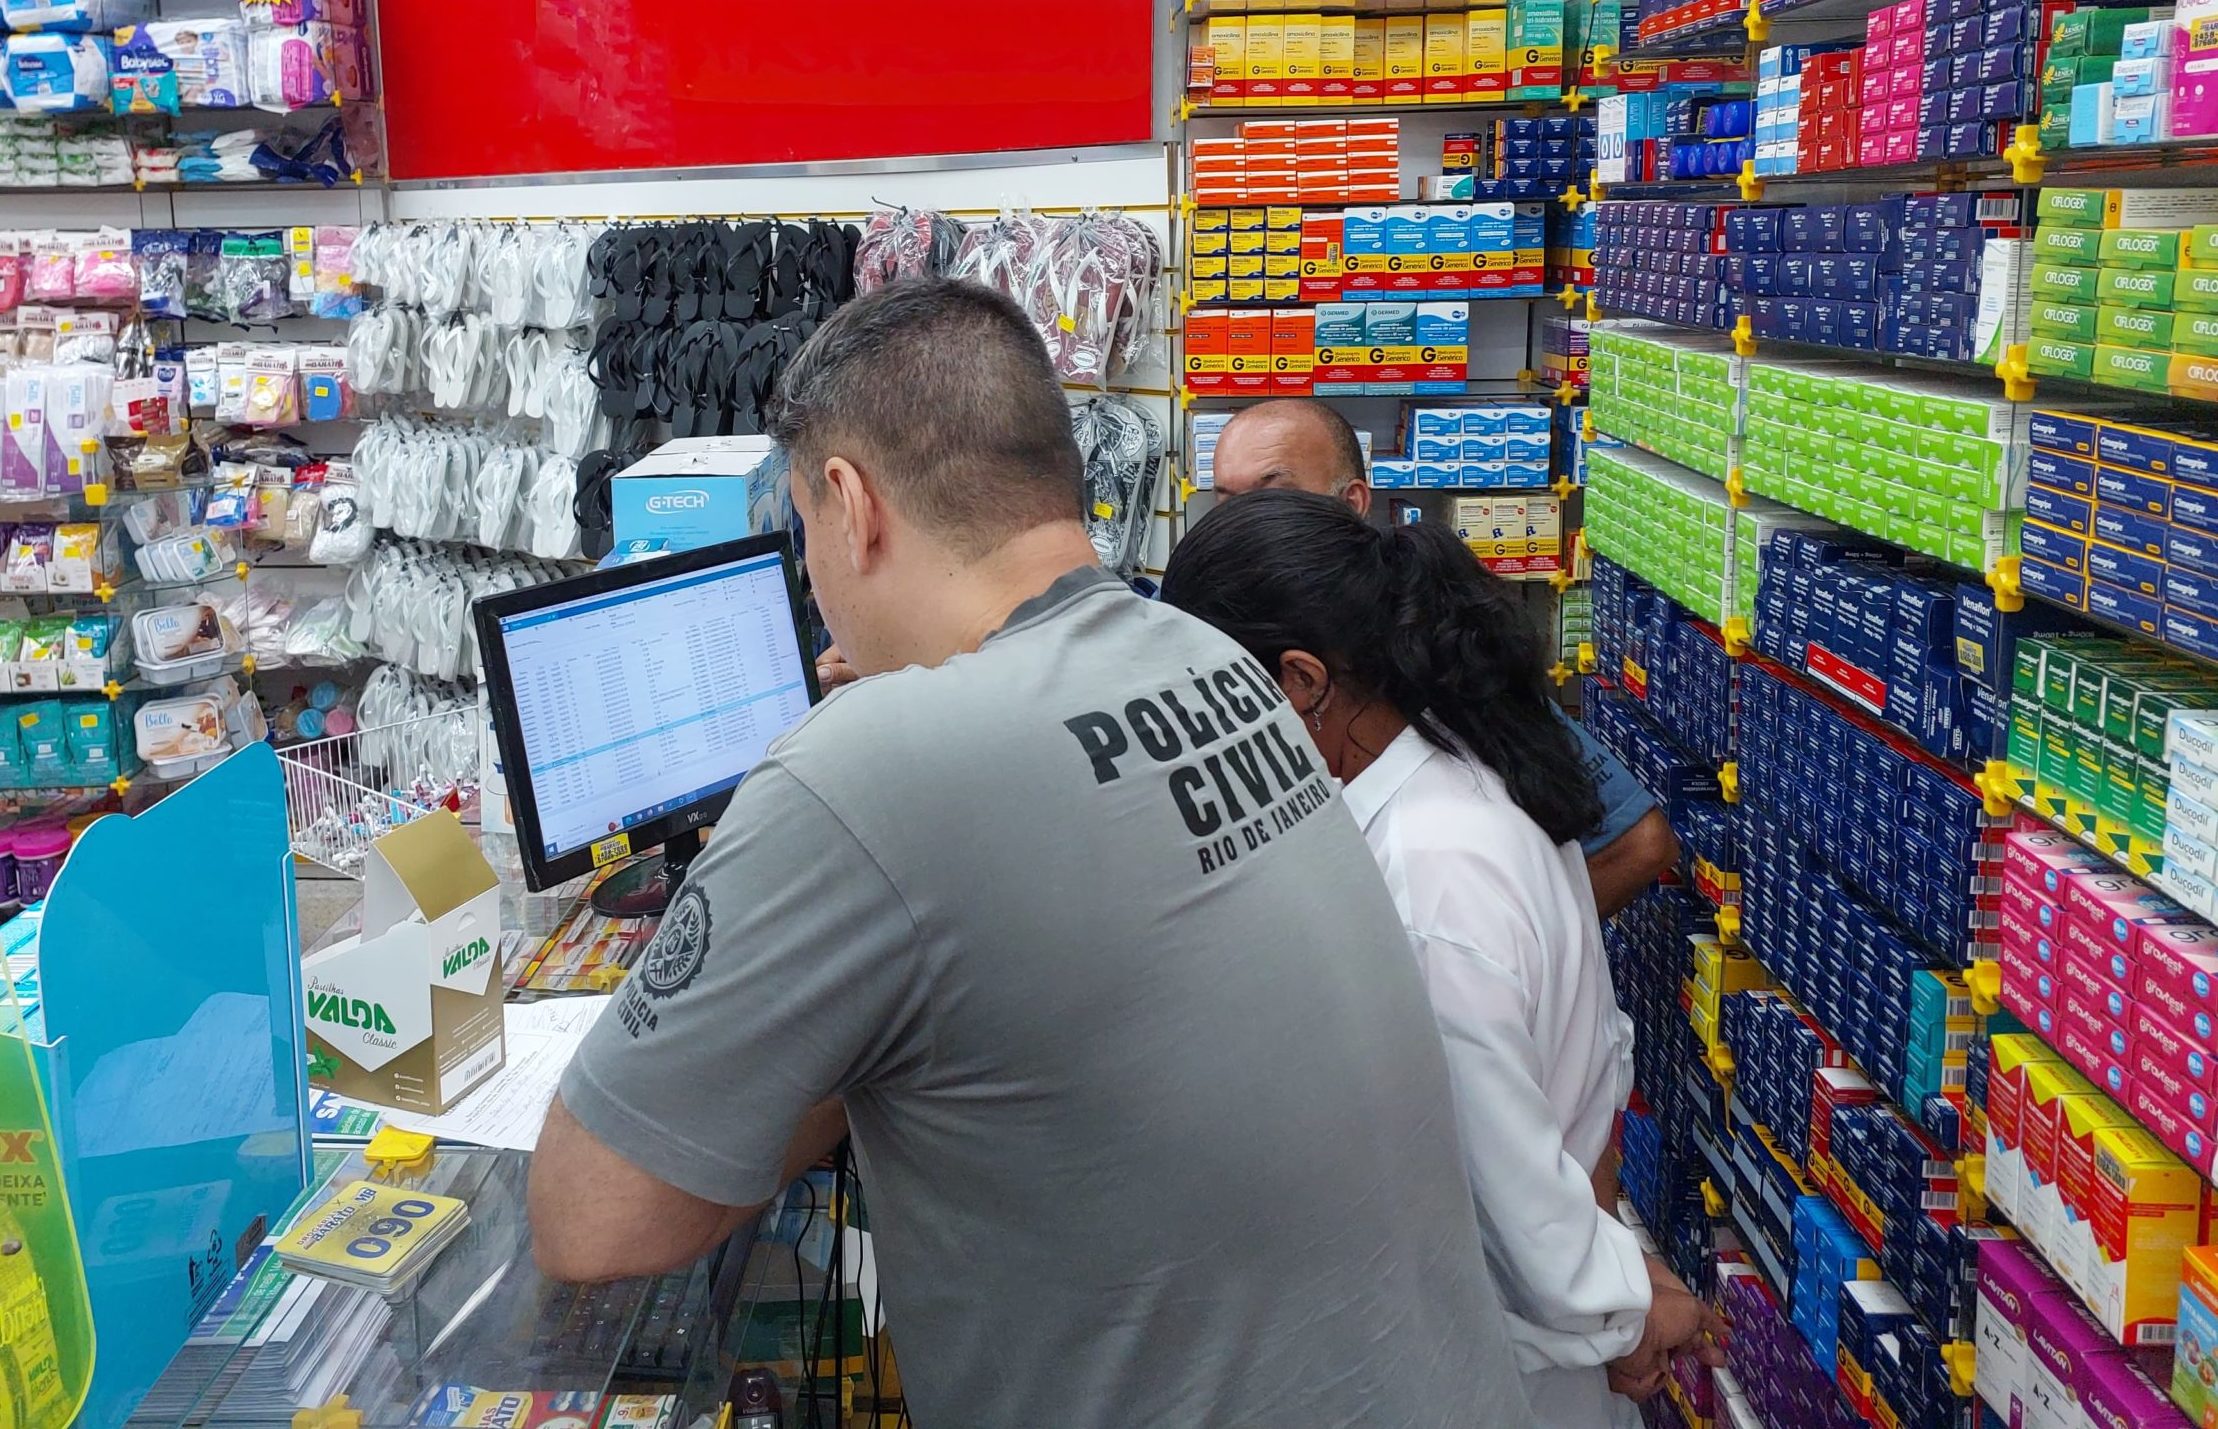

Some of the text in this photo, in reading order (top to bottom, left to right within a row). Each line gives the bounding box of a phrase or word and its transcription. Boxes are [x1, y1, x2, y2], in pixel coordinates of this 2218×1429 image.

[2066, 25, 2085, 34] ARNICA
[1526, 49, 1539, 63] G
[1252, 66, 1260, 75] G
[1289, 64, 1297, 74] G
[1323, 66, 1332, 75] G
[1433, 63, 1441, 72] G
[1621, 60, 1633, 72] G
[2055, 68, 2073, 77] ARNICA
[2052, 116, 2070, 124] ARNICA
[2051, 195, 2085, 209] CIFLOGEX
[2048, 234, 2082, 248] CIFLOGEX
[2117, 238, 2157, 252] CIFLOGEX
[1304, 262, 1316, 274] G
[1345, 256, 1359, 271] G
[1359, 261, 1383, 269] Genérico
[1388, 256, 1402, 271] G
[1403, 262, 1426, 270] Genérico
[1430, 255, 1444, 270] G
[1445, 261, 1468, 269] Genérico
[1473, 254, 1487, 268] G
[2045, 272, 2080, 286] CIFLOGEX
[2115, 276, 2155, 292] CIFLOGEX
[2044, 309, 2078, 324] CIFLOGEX
[2114, 315, 2154, 332] CIFLOGEX
[1319, 348, 1334, 364] G
[1335, 355, 1361, 363] Genérico
[1370, 348, 1384, 364] G
[1421, 347, 1436, 363] G
[2040, 345, 2076, 362] CIFLOGEX
[1190, 357, 1202, 370] G
[1232, 358, 1244, 370] G
[1276, 357, 1288, 370] G
[1577, 358, 1587, 369] G
[2111, 355, 2152, 372] CIFLOGEX
[1495, 544, 1505, 555] G
[1527, 542, 1538, 553] G
[1963, 595, 1992, 617] Venaflon
[1977, 686, 2009, 709] Venafon
[2179, 727, 2214, 755] Ducodil
[1169, 722, 1316, 837] CIVIL
[2179, 762, 2212, 790] Ducodil
[2174, 798, 2209, 825] Ducodil
[1198, 778, 1331, 874] RIO DE JANEIRO
[2171, 833, 2206, 862] Ducodil
[2170, 868, 2204, 898] Ducodil
[443, 937, 490, 979] VALDA
[307, 976, 344, 995] Pastilhas
[307, 990, 396, 1034] VALDA
[617, 1000, 641, 1038] CIVIL
[363, 1032, 398, 1050] Classic
[346, 1200, 435, 1258] 090
[1984, 1273, 2016, 1310] LAVITAN
[1984, 1324, 2000, 1350] A-Z
[2033, 1329, 2067, 1370] LAVITAN
[2033, 1383, 2050, 1409] A-Z
[2088, 1392, 2128, 1429] LAVITA
